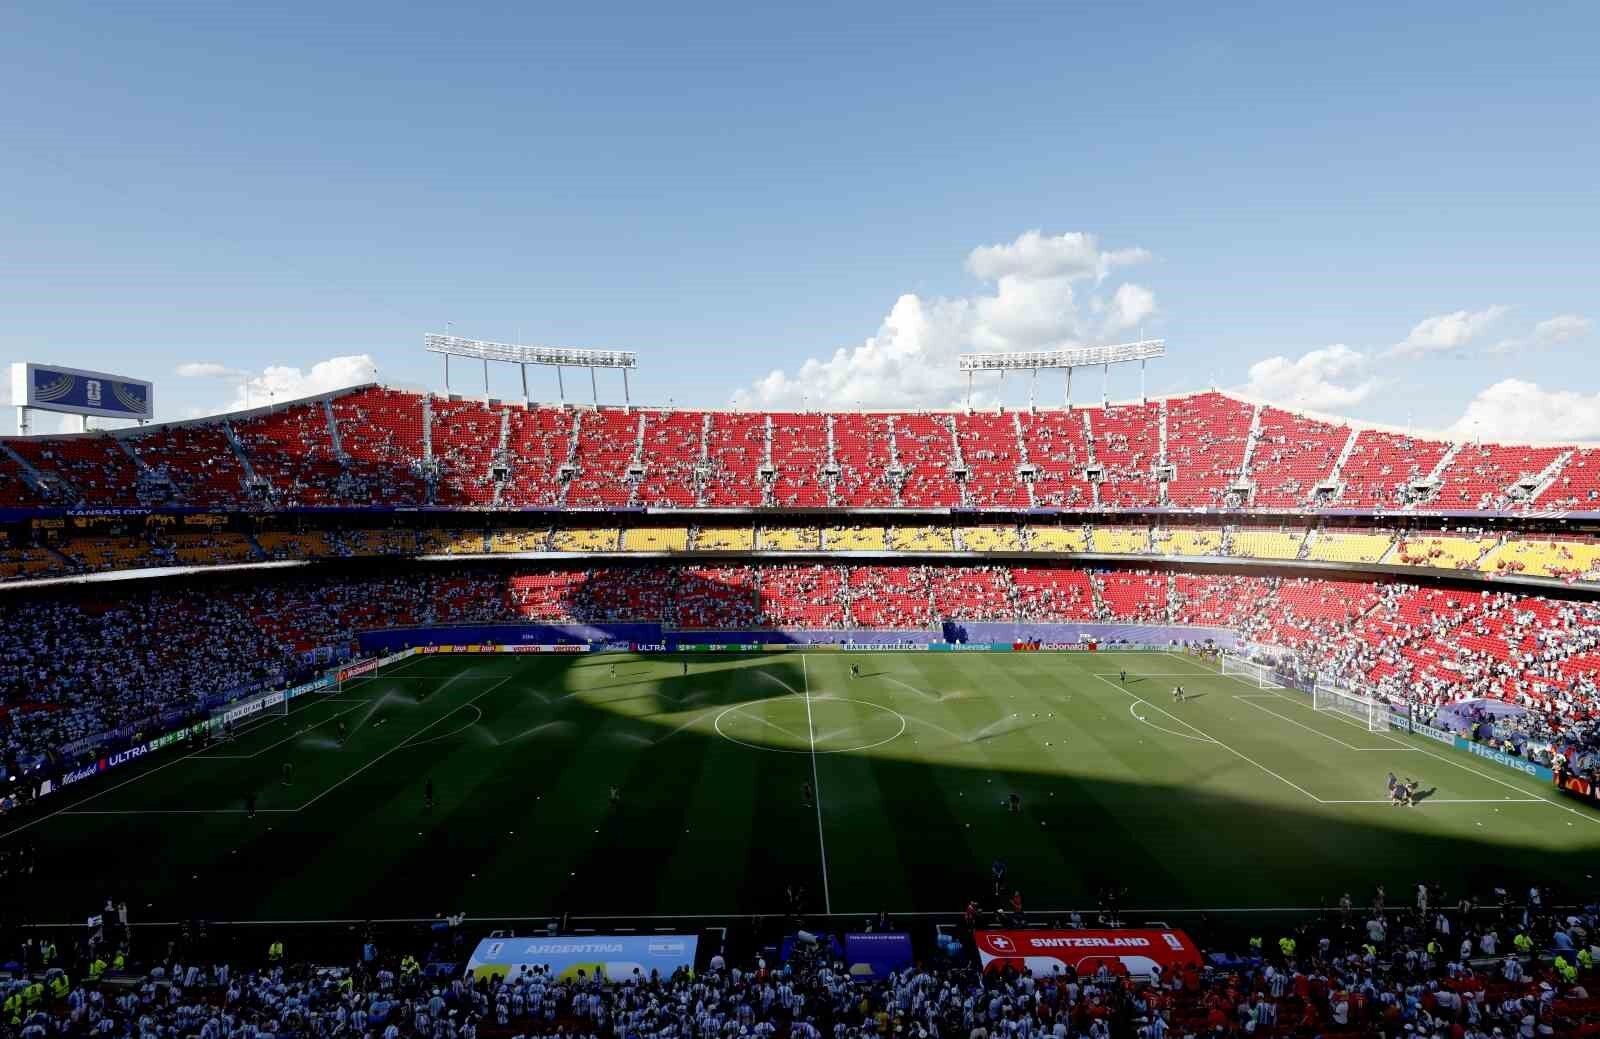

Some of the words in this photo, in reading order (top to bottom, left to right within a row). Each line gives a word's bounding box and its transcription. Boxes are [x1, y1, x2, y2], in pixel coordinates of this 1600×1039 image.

[637, 643, 666, 651] ULTRA
[108, 744, 148, 767] ULTRA
[1468, 741, 1536, 776] Hisense
[1030, 937, 1150, 948] SWITZERLAND
[524, 943, 624, 954] ARGENTINA
